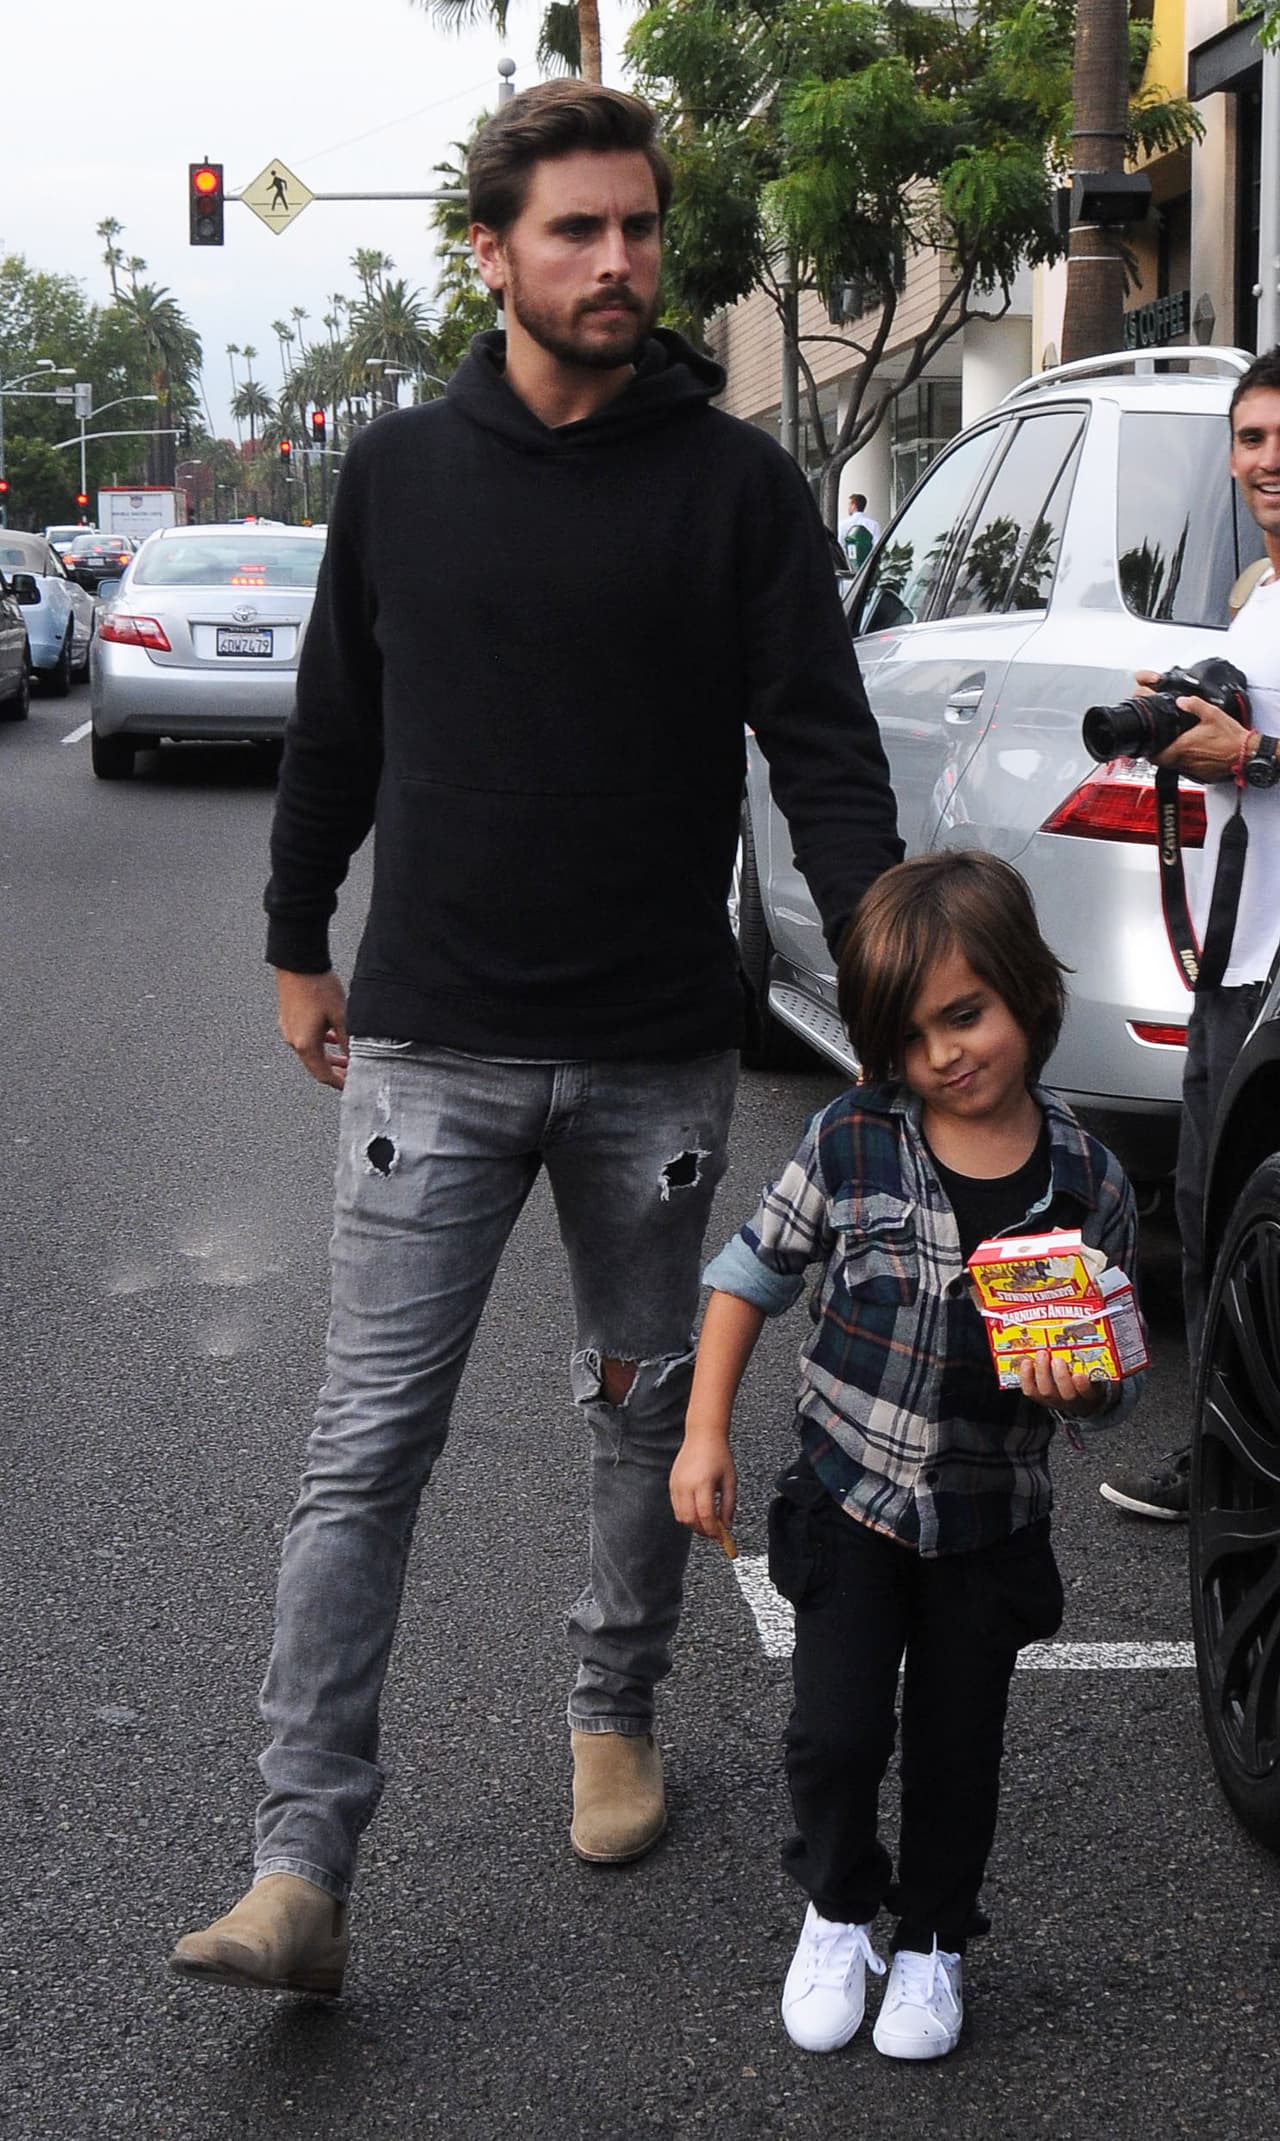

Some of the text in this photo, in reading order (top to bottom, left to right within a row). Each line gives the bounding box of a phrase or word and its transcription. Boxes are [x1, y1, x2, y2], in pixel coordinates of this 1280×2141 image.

[1140, 292, 1185, 347] COFFEE
[1162, 803, 1178, 866] Canon
[1048, 1304, 1092, 1320] ANIMALS
